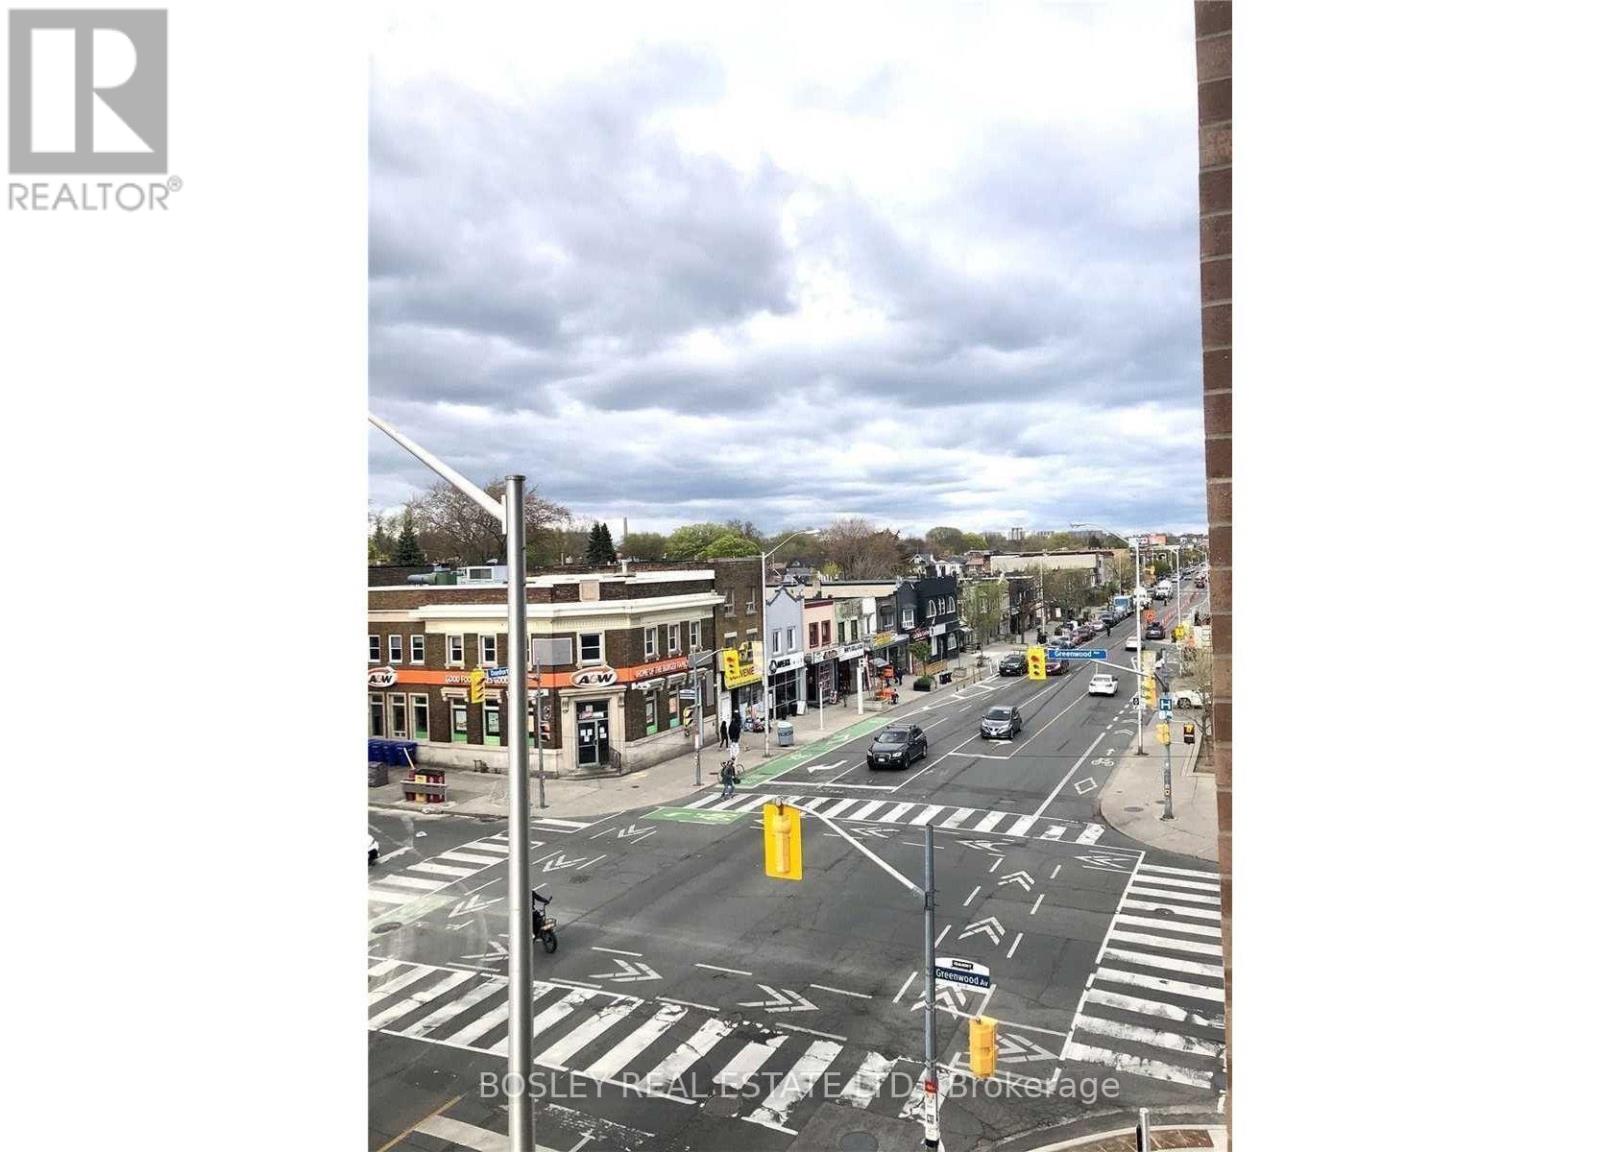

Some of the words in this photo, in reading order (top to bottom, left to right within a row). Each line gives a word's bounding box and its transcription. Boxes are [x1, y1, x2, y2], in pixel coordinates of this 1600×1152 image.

[1054, 649, 1092, 658] Greenwood
[578, 673, 613, 684] A&W
[1161, 700, 1171, 710] H
[935, 968, 979, 985] Greenwood
